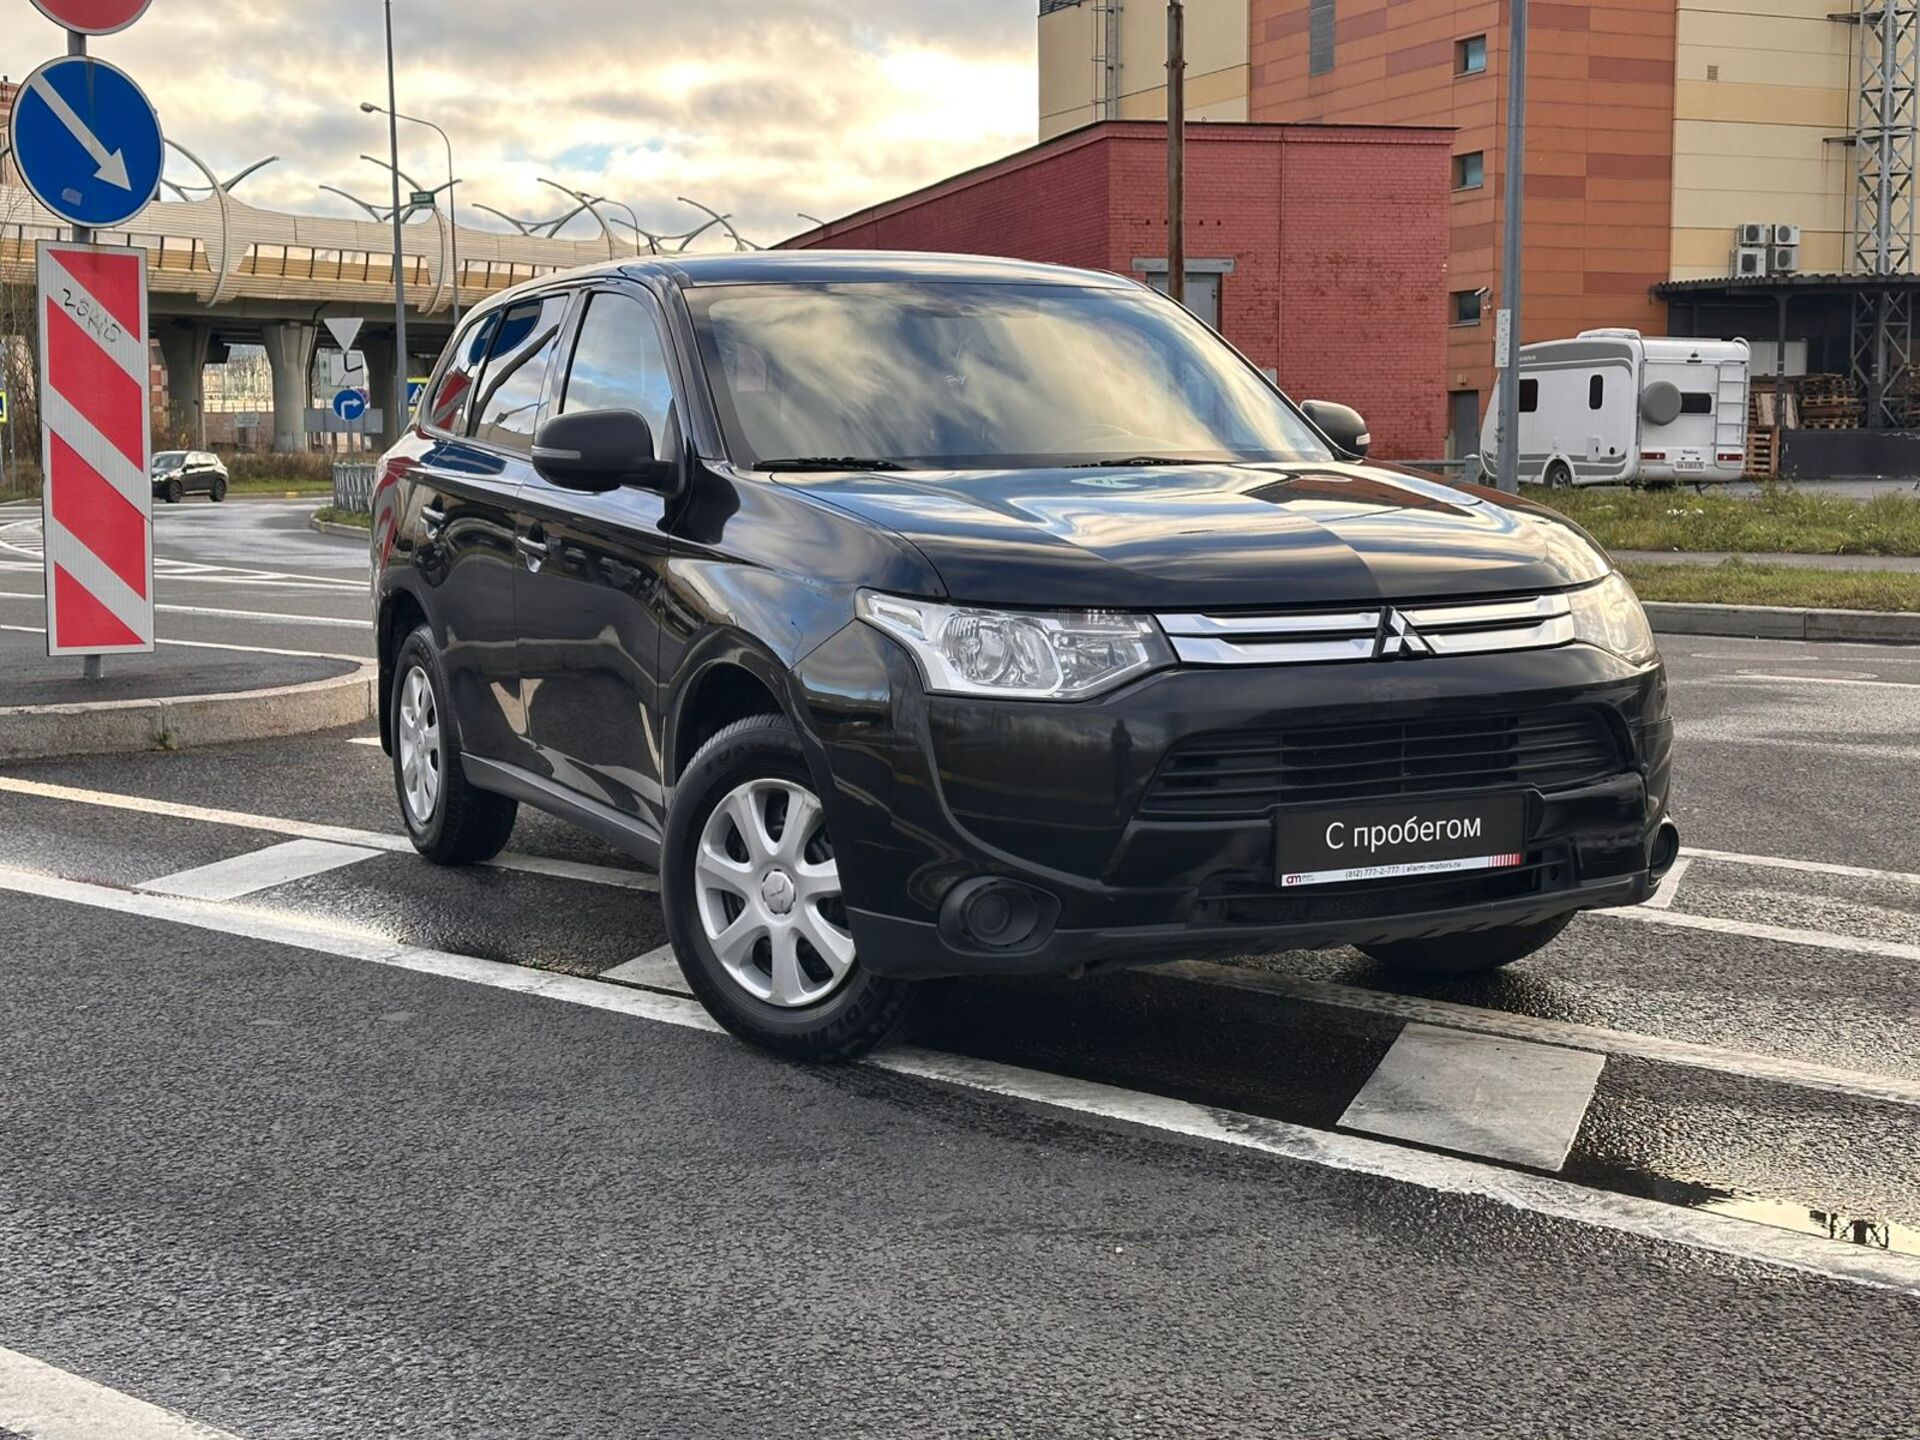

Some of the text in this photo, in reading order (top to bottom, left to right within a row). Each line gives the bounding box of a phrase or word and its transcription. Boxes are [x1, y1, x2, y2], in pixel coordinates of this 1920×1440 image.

[1325, 815, 1482, 853] С пробегом
[1365, 866, 1400, 877] 777-2-777
[1406, 861, 1462, 873] alarm-motors.ru
